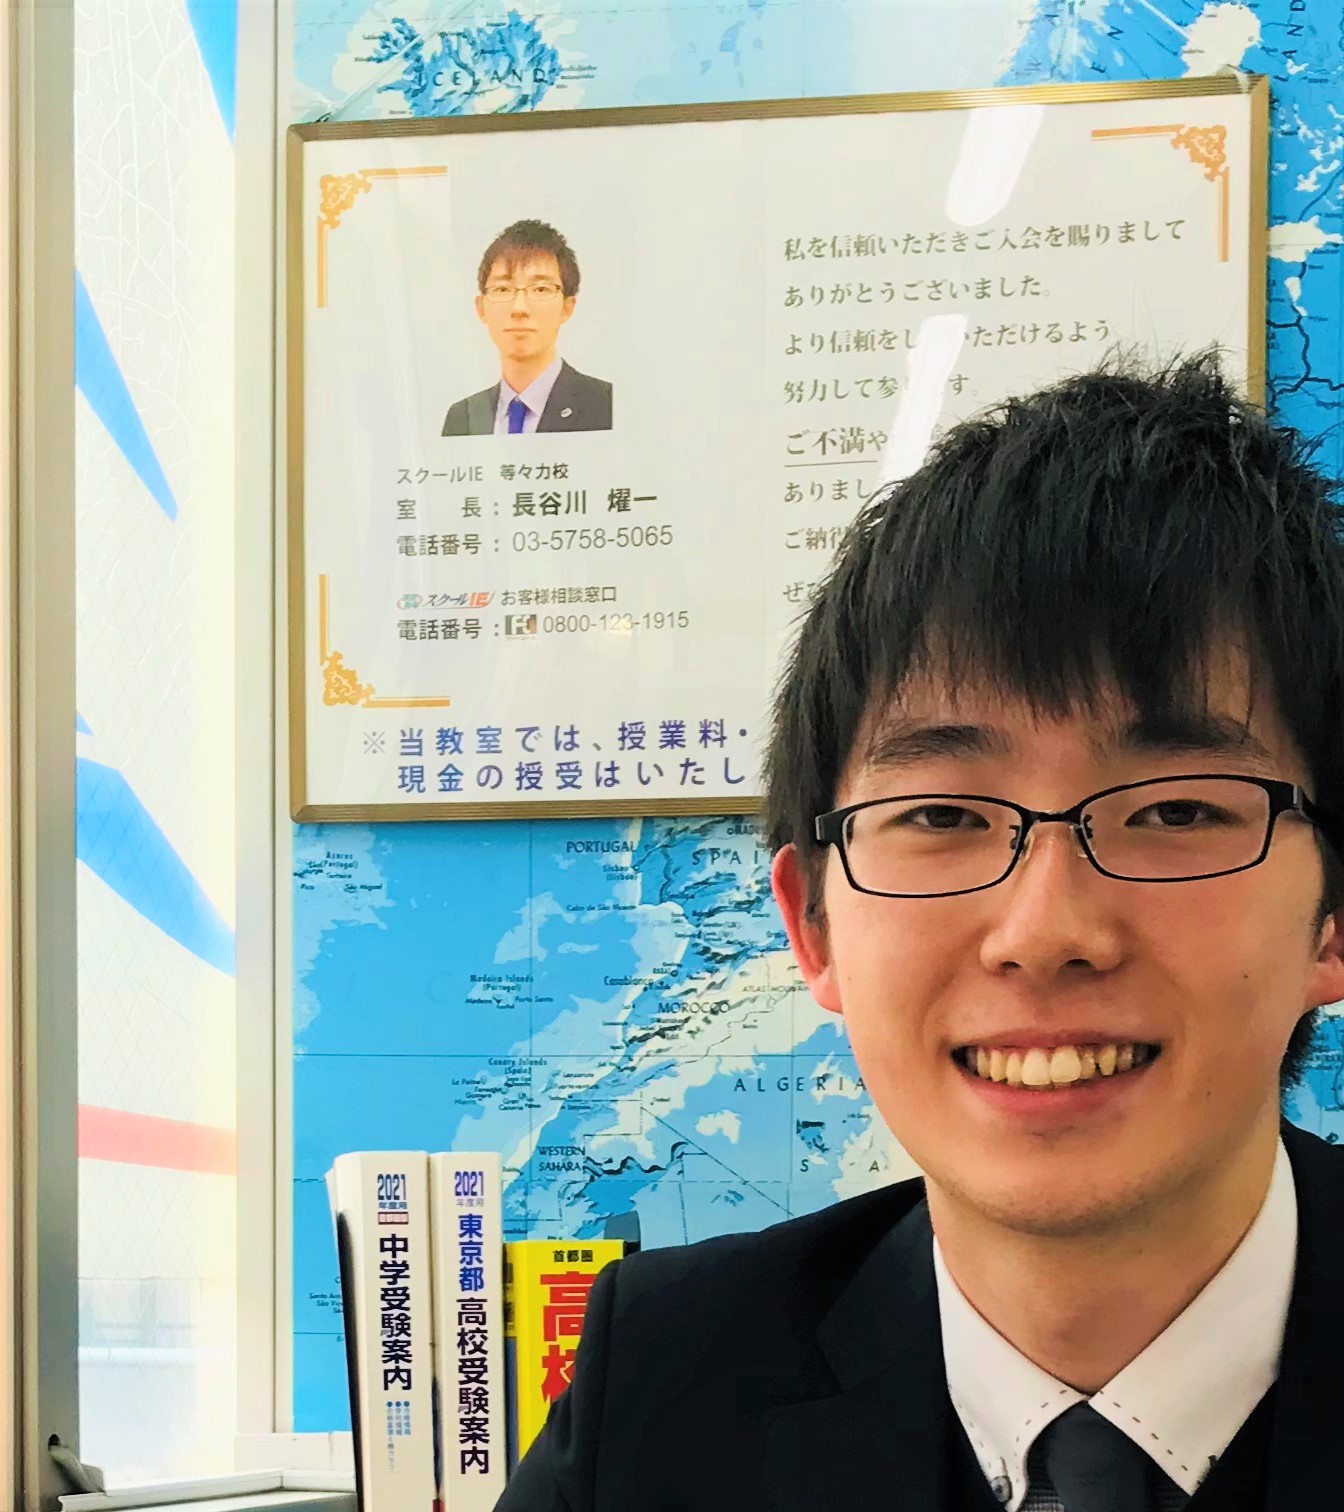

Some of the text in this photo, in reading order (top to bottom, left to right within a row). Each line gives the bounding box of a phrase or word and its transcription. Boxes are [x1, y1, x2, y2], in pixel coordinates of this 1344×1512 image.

[784, 218, 1187, 261] 私を信頼いただきご入会を賜りまして
[784, 273, 1052, 308] ありがとうございました。
[784, 319, 1112, 356] より信頼をしただけるよう
[784, 373, 979, 405] 努力して参す。
[396, 463, 570, 484] スクールIE 等々力校
[512, 490, 587, 517] 長谷川
[512, 525, 674, 552] 03-5758-5065
[500, 586, 618, 605] お客様相談窓口
[566, 840, 635, 854] PORTUGAL
[691, 849, 772, 866] SPAI
[657, 1001, 730, 1015] MOROCCO
[734, 1076, 867, 1093] ALGERIA
[377, 1174, 406, 1200] 2021
[455, 1171, 484, 1197] 2021
[378, 1233, 412, 1391] 中学受験案内
[456, 1213, 489, 1475] 東京都 高校受験案内
